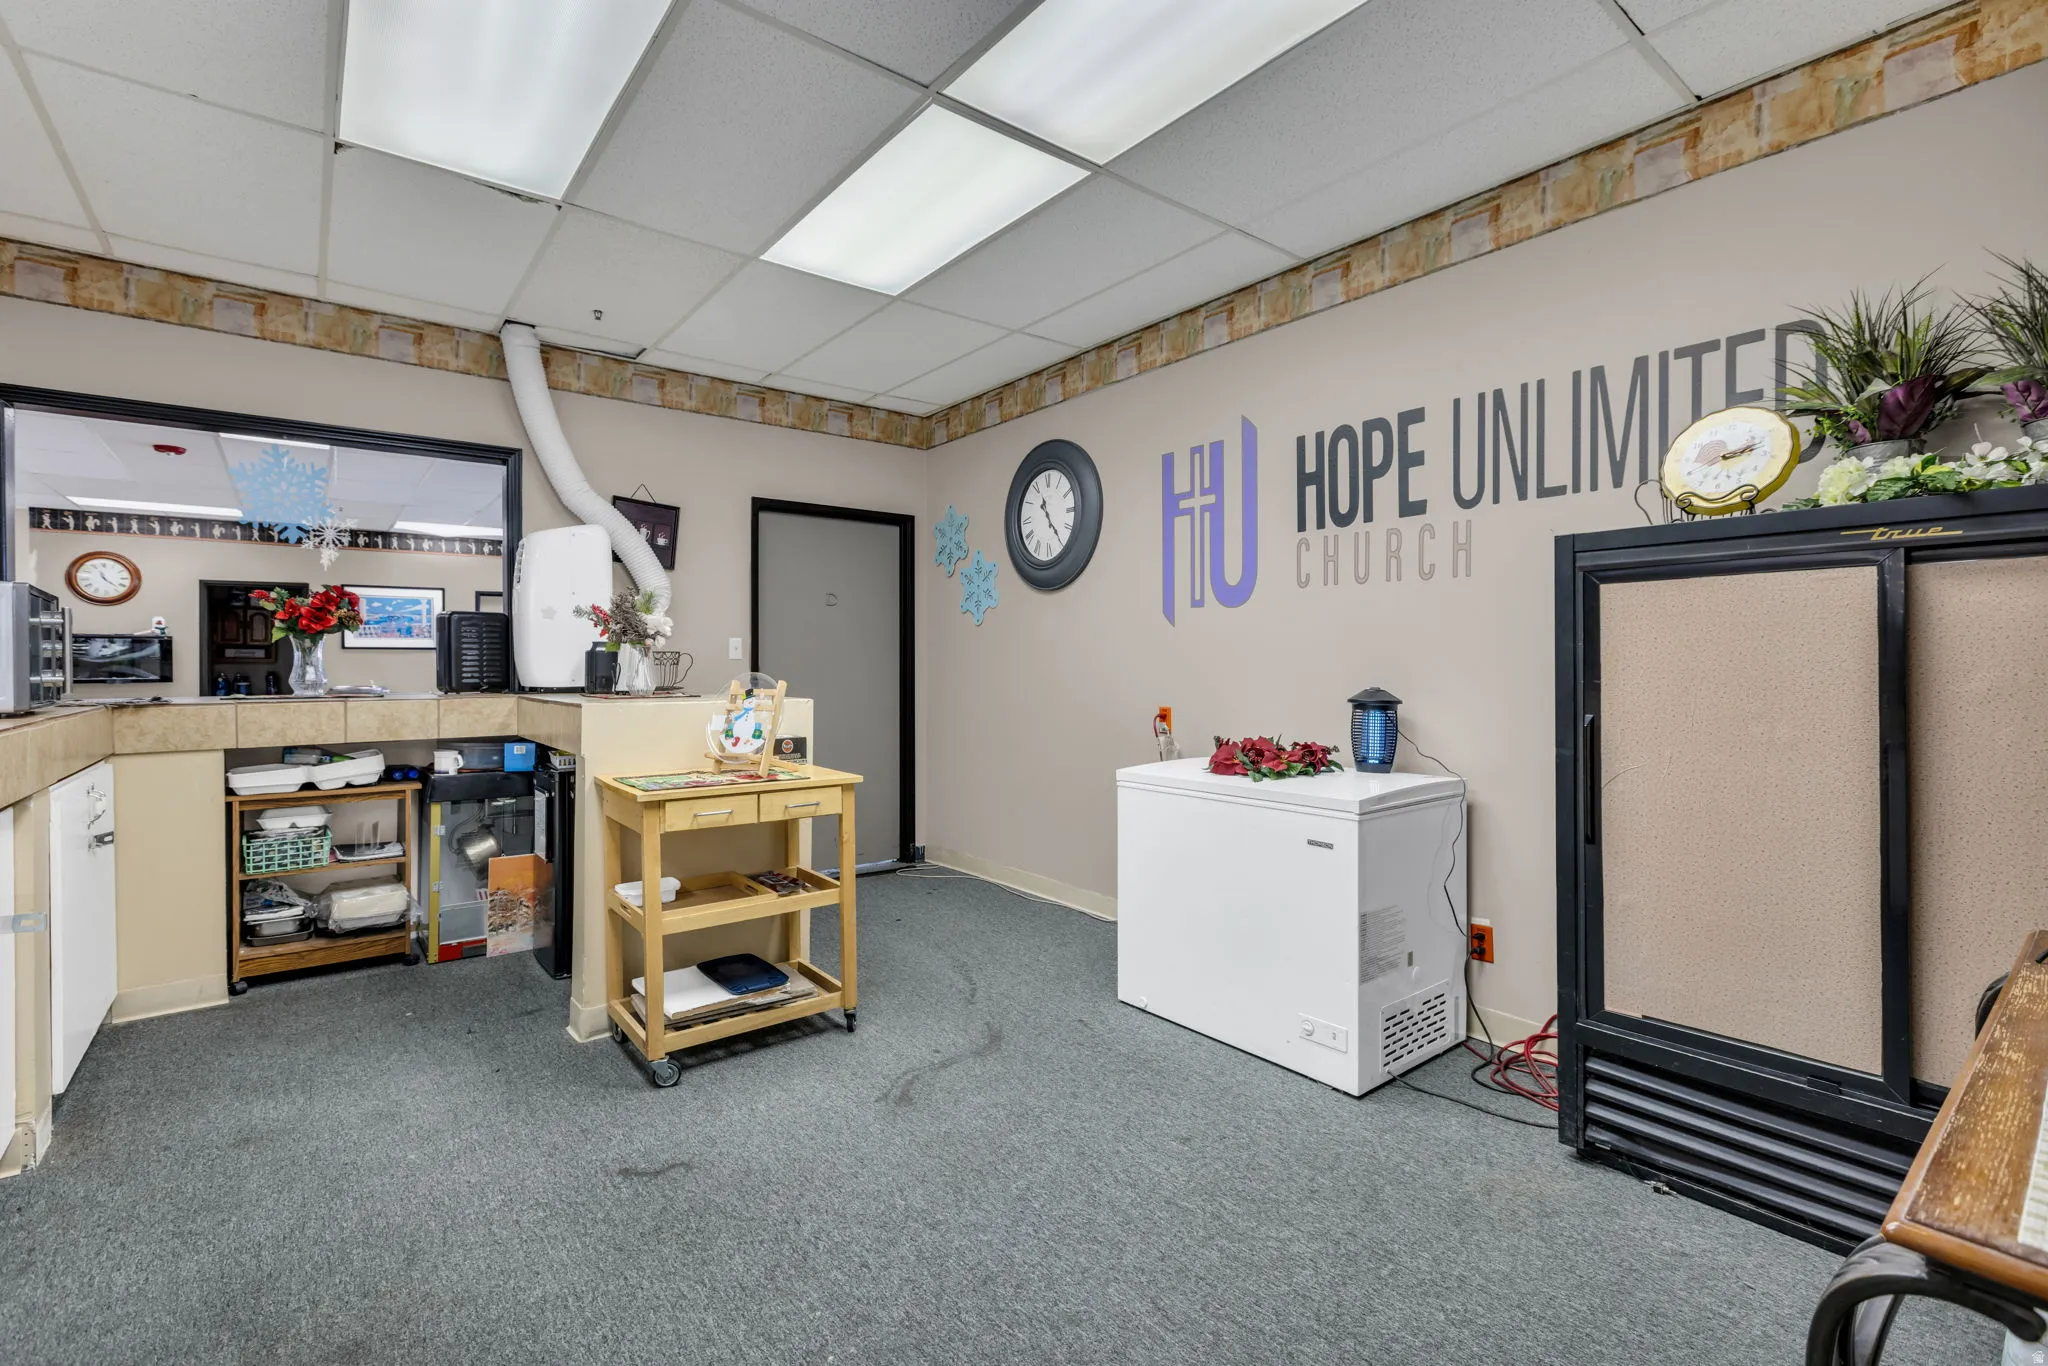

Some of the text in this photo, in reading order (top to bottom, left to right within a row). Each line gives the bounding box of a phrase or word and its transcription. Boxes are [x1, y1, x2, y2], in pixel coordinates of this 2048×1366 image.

[1296, 319, 1828, 533] HOPE UNLIMITED
[1297, 519, 1472, 589] CHURCH
[1840, 526, 1963, 541] true
